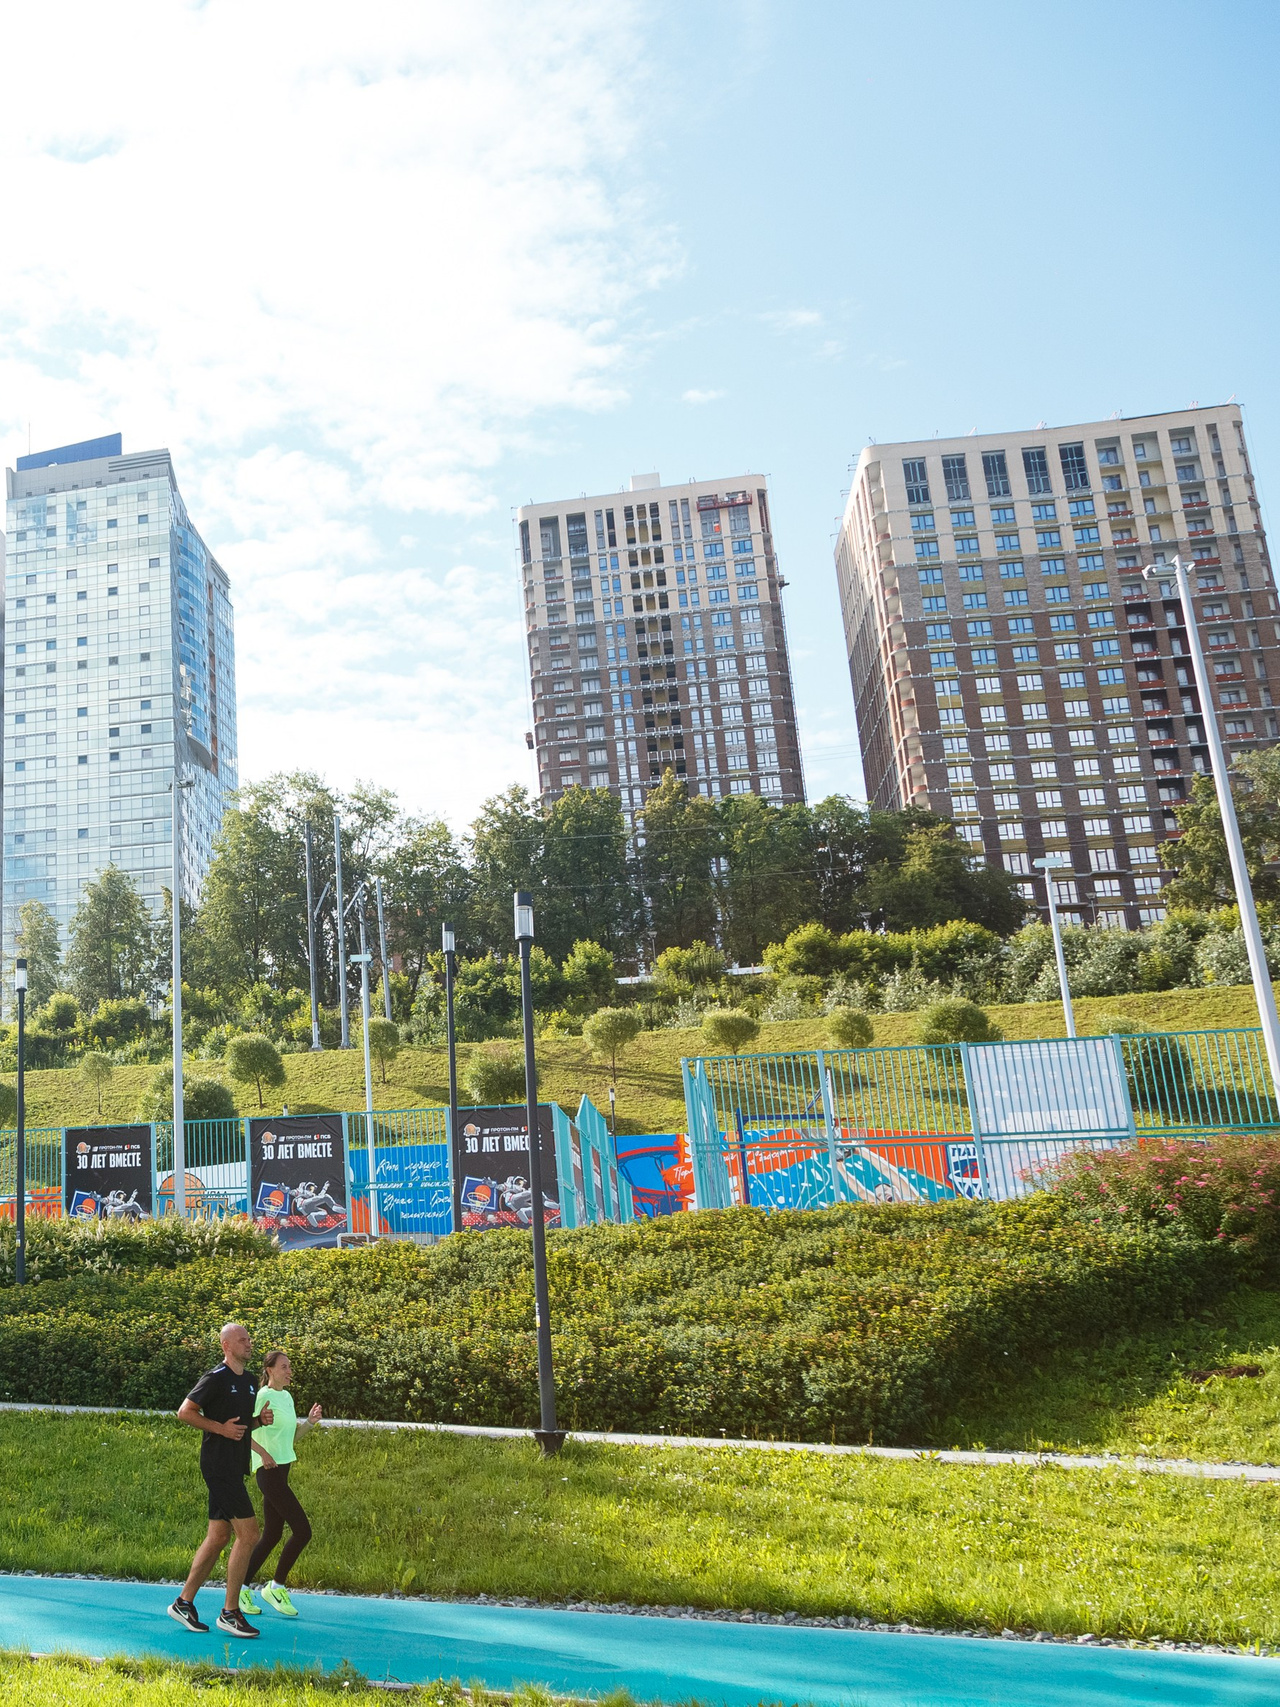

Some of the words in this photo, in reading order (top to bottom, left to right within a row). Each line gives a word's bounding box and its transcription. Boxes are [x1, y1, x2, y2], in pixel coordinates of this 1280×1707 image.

[262, 1144, 274, 1160] 30
[277, 1143, 295, 1159] ЛЕТ
[297, 1142, 333, 1159] ВМЕСТЕ
[465, 1137, 479, 1153] 30
[482, 1136, 500, 1152] ЛЕТ
[503, 1134, 543, 1152] ВМЕС
[76, 1154, 88, 1169] 30
[90, 1153, 107, 1169] ЛЕТ
[109, 1151, 142, 1168] ВМЕСТЕ
